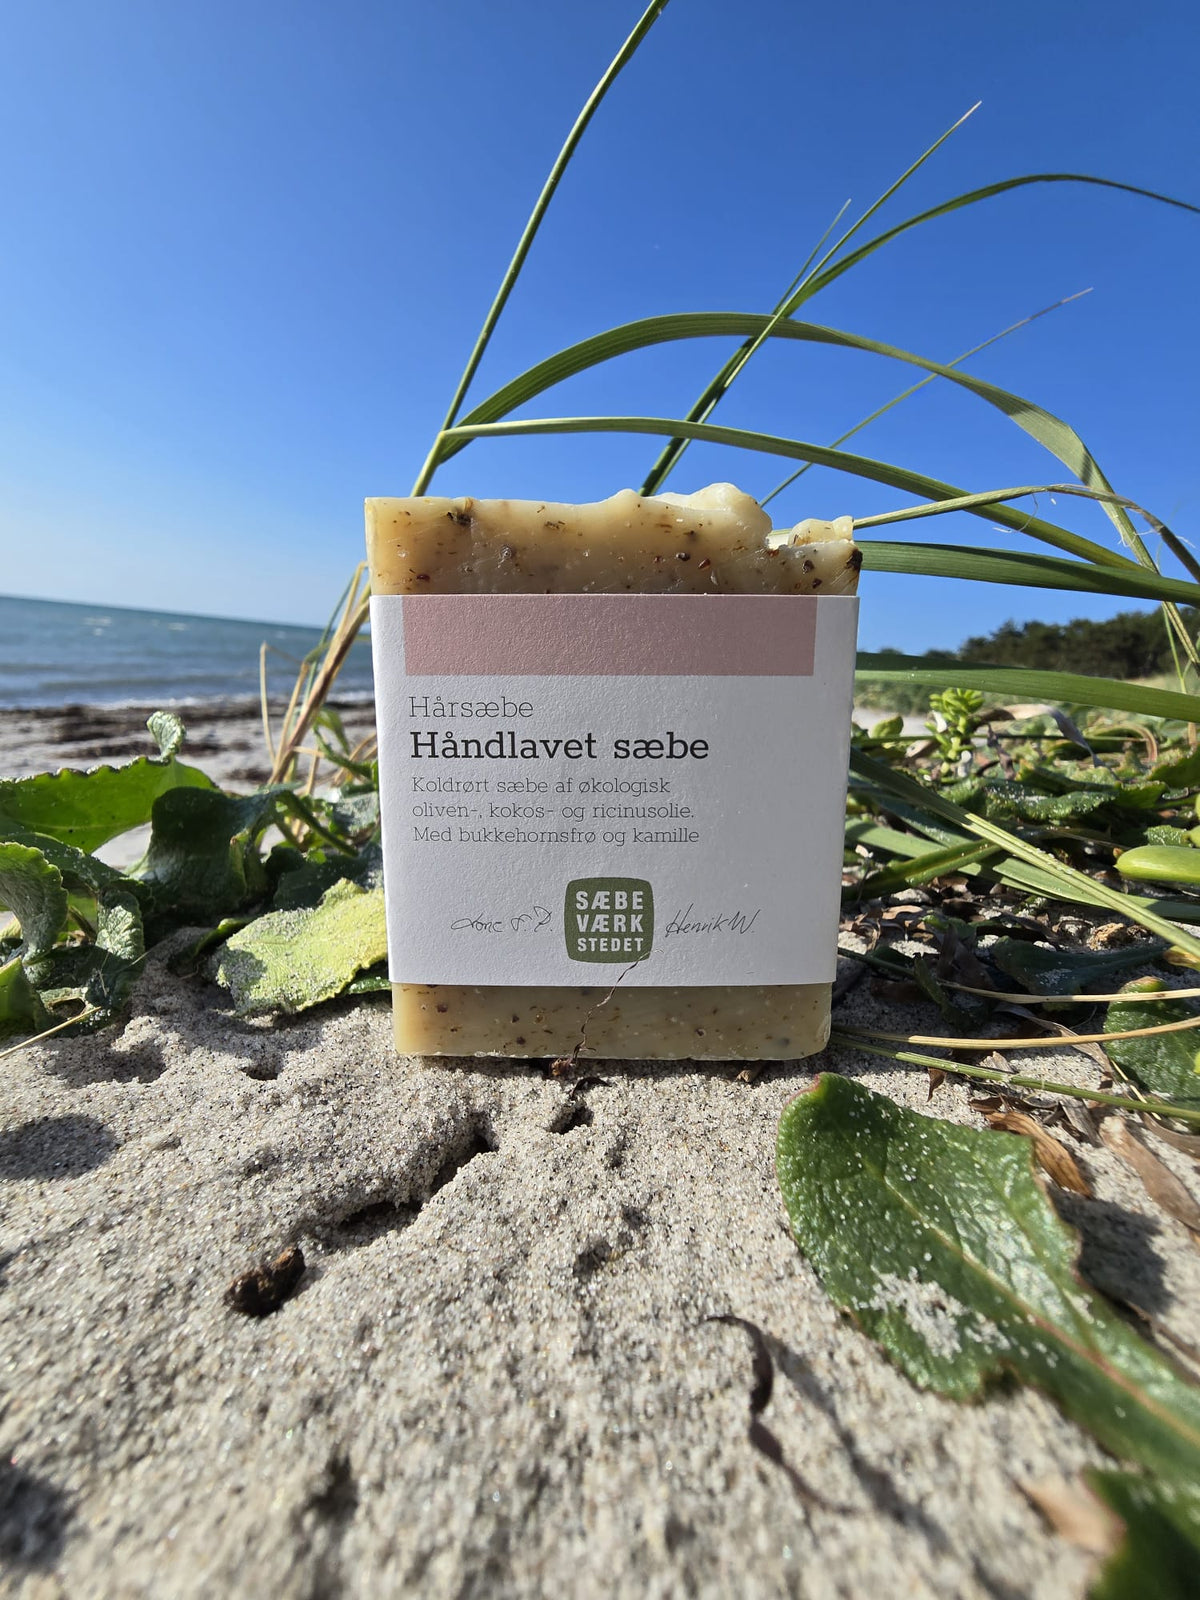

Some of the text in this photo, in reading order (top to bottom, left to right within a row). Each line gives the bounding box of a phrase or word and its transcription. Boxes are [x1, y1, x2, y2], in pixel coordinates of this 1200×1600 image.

[408, 696, 534, 718] Hårsæbe
[410, 731, 709, 759] Håndlavet sæbe
[411, 777, 671, 797] Koldrørt sæbe af økologisk
[412, 803, 694, 821] oliven-, kokos- og ricinusolie.
[413, 827, 700, 846] Med bukkehornsfrø og kamille
[575, 890, 644, 911] SÆBE
[576, 914, 644, 933] VÆRK
[577, 938, 643, 952] STEDET
